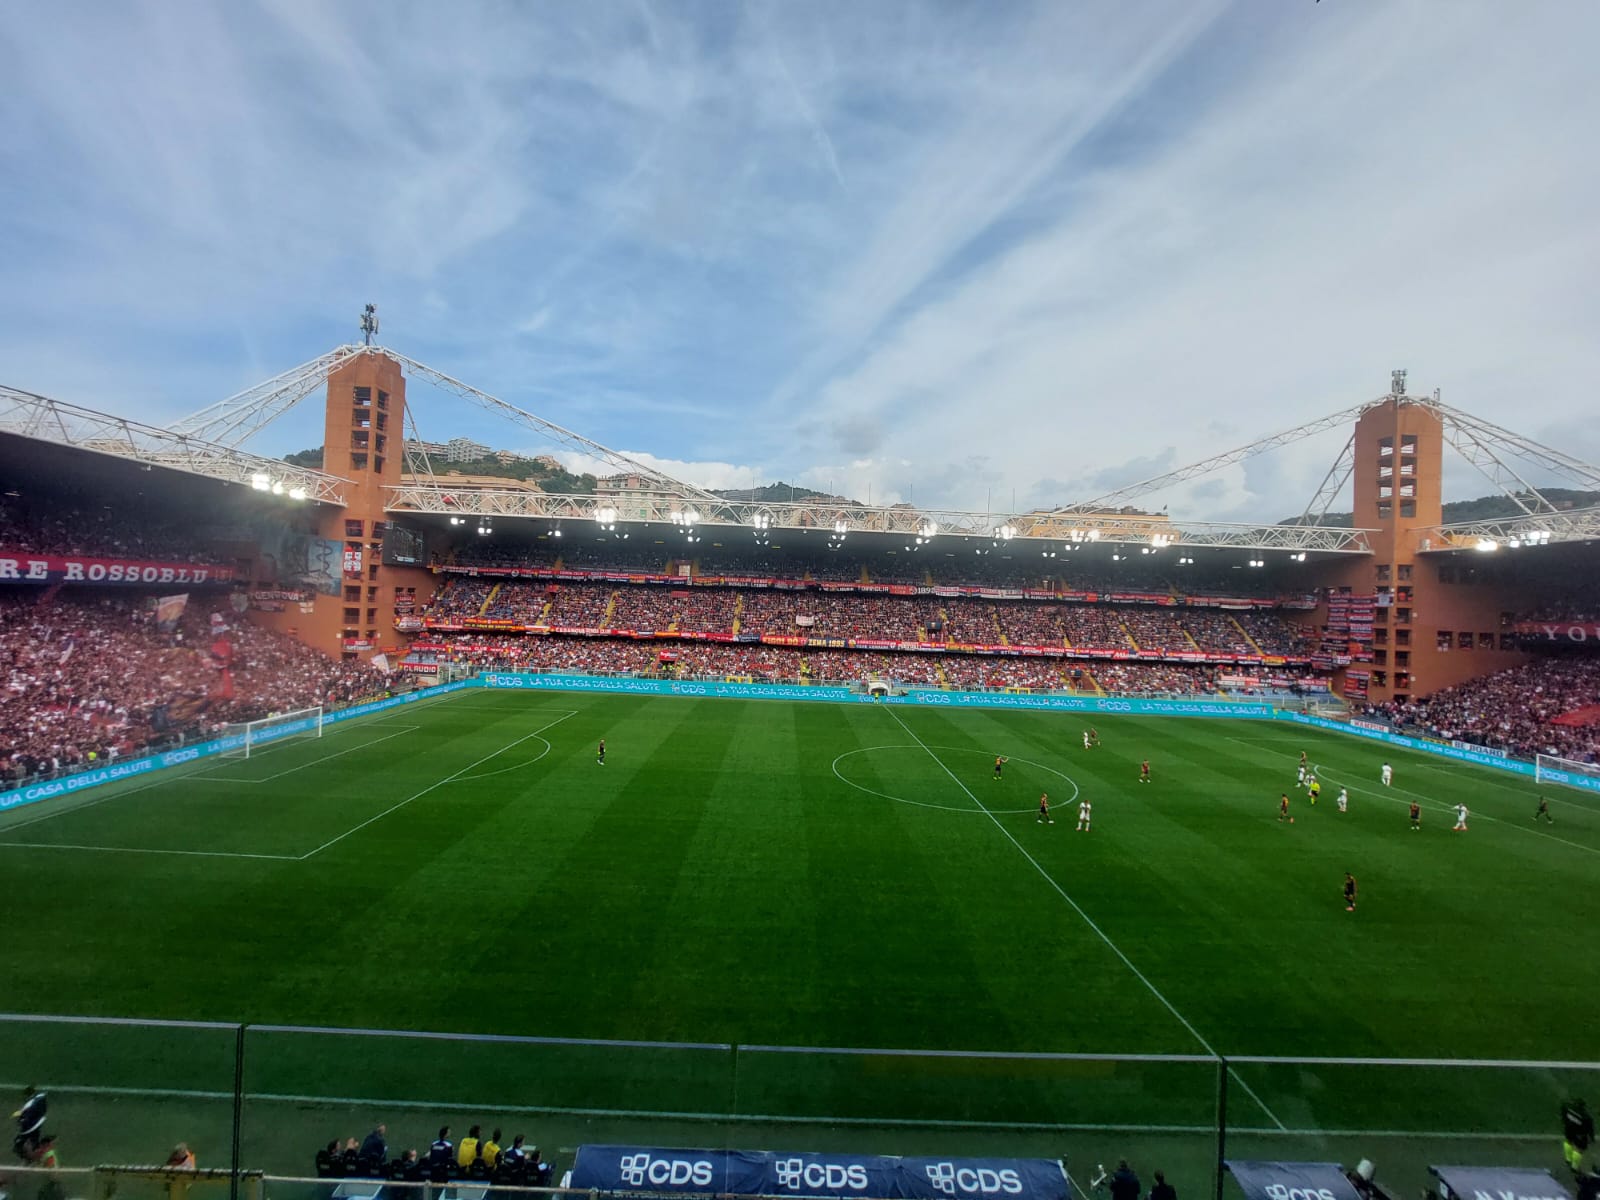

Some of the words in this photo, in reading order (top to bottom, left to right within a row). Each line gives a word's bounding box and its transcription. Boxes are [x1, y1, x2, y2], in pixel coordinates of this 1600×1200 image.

[63, 562, 208, 584] ROSSOBLU
[404, 665, 436, 673] CLAUDIO
[498, 677, 523, 686] CDS
[625, 682, 660, 691] SALUTE
[682, 684, 706, 694] CDS
[811, 689, 846, 699] SALUTE
[1107, 701, 1131, 711] CDS
[1492, 758, 1524, 771] SALUTE
[26, 782, 64, 799] CASA
[67, 772, 108, 789] DELLA
[110, 759, 153, 778] SALUTE
[648, 1160, 713, 1186] CDS
[803, 1163, 868, 1189] CDS
[956, 1168, 1023, 1193] CDS
